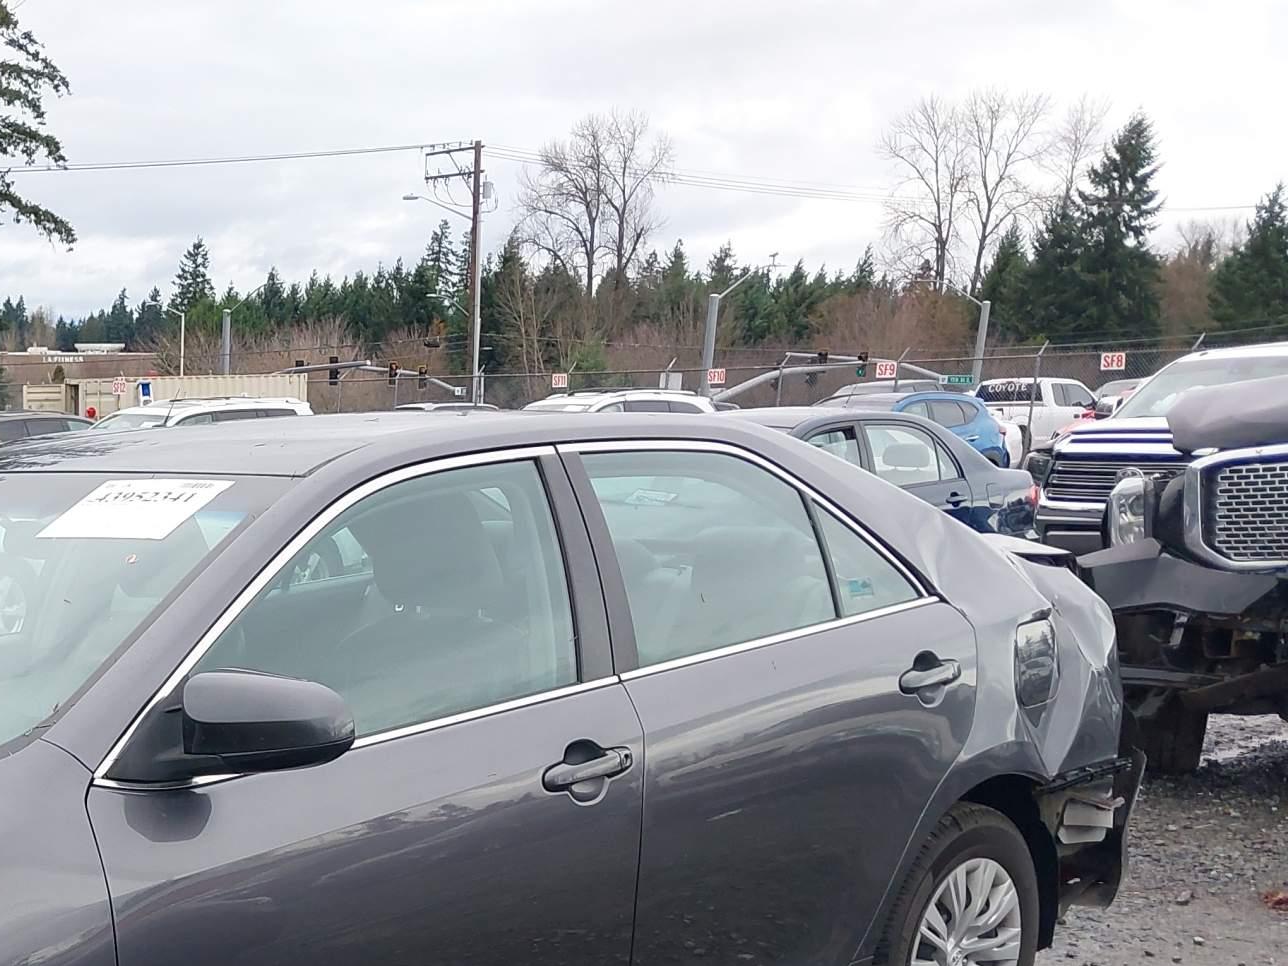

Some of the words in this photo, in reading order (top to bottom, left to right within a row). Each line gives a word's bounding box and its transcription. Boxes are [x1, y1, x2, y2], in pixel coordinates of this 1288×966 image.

[1103, 354, 1123, 368] SF8
[878, 363, 895, 376] SF9
[553, 375, 566, 386] SF11
[708, 370, 725, 382] SF10
[113, 382, 126, 393] SF12
[988, 382, 1027, 393] COYOTE
[94, 491, 197, 502] 43952341
